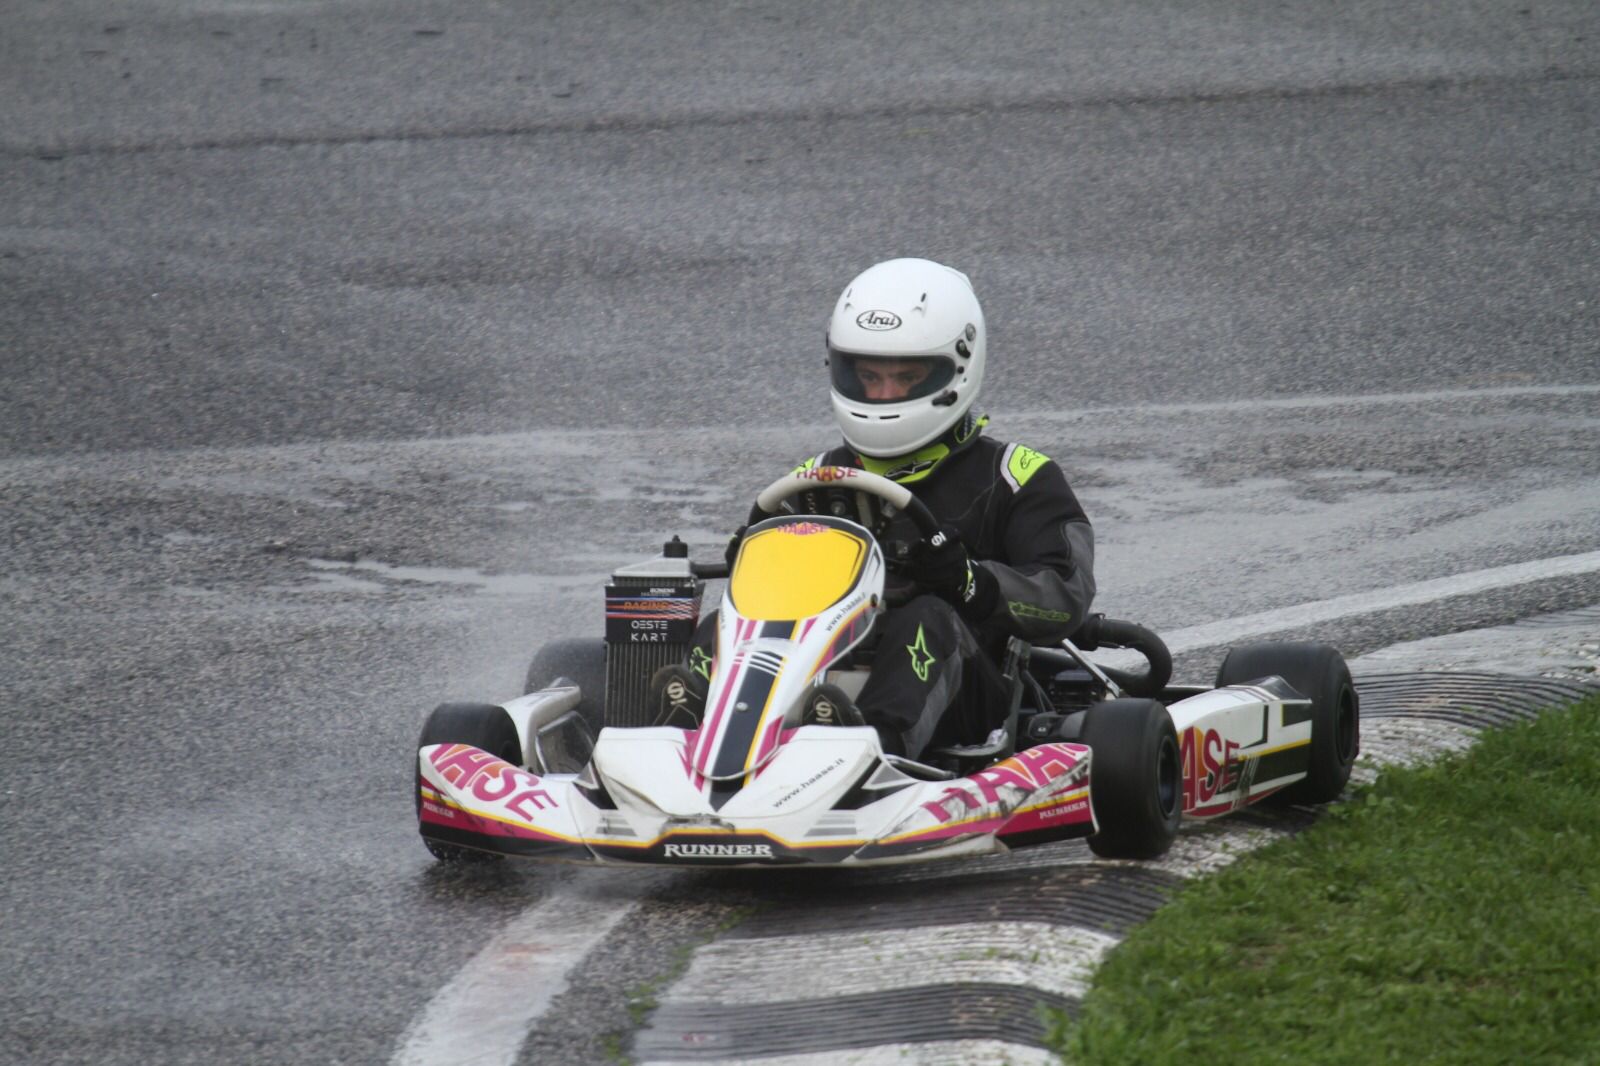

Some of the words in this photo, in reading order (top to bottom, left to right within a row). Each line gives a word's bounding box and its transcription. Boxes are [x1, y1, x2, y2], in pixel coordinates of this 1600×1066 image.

[859, 311, 896, 326] Arai
[796, 466, 859, 482] HAASE
[631, 620, 668, 629] OESTE
[631, 633, 668, 642] KART
[772, 758, 845, 808] www.haase.it
[663, 843, 776, 859] RUNNER
